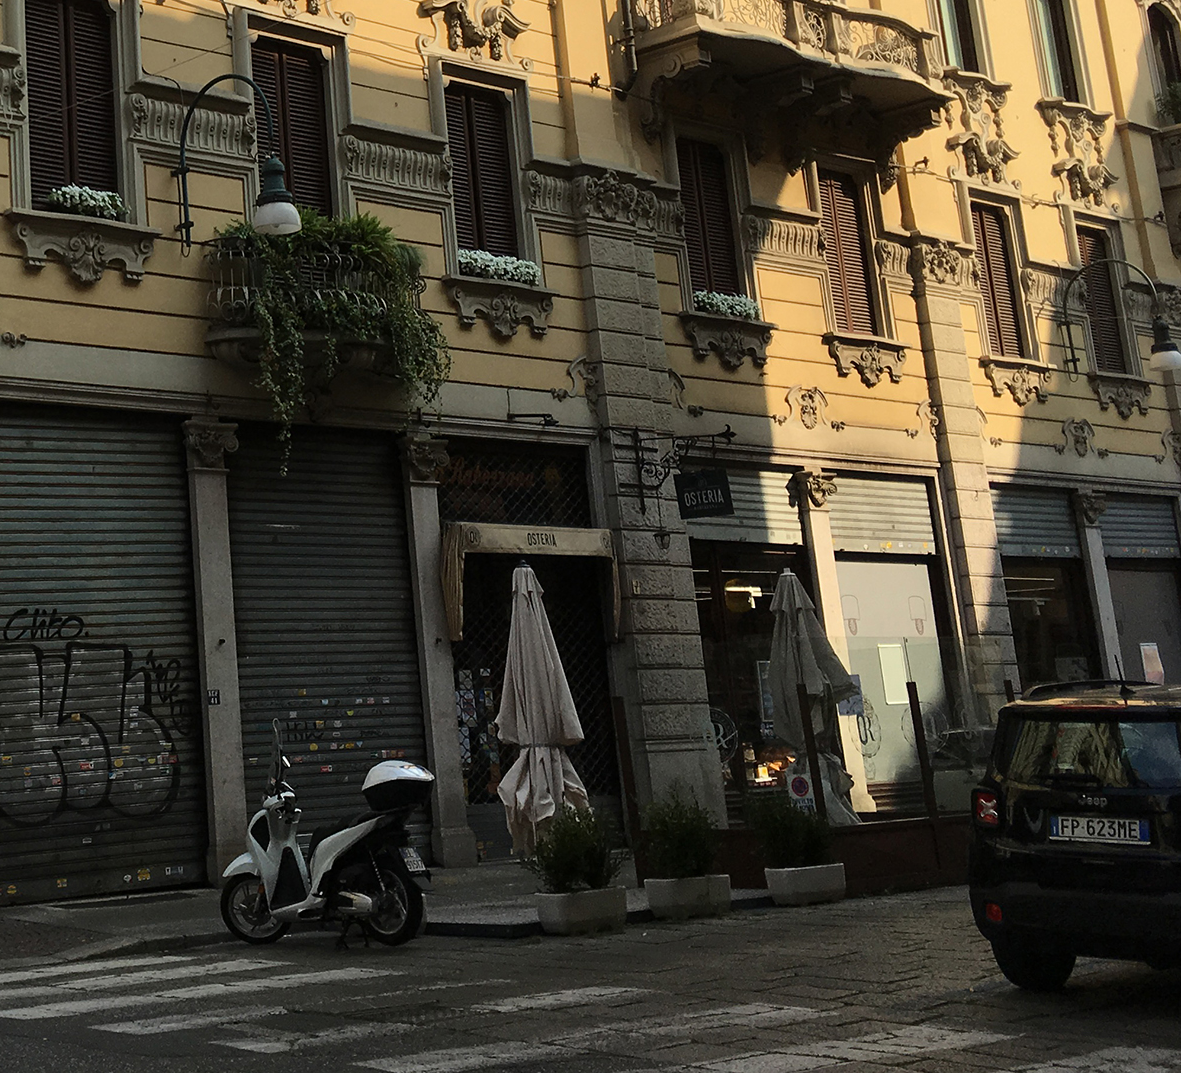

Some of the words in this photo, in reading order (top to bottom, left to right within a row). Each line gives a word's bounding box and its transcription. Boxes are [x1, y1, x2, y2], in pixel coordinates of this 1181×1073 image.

[684, 489, 725, 508] OSTERIA
[527, 533, 558, 548] OSTERIA
[1078, 794, 1108, 808] Jeep
